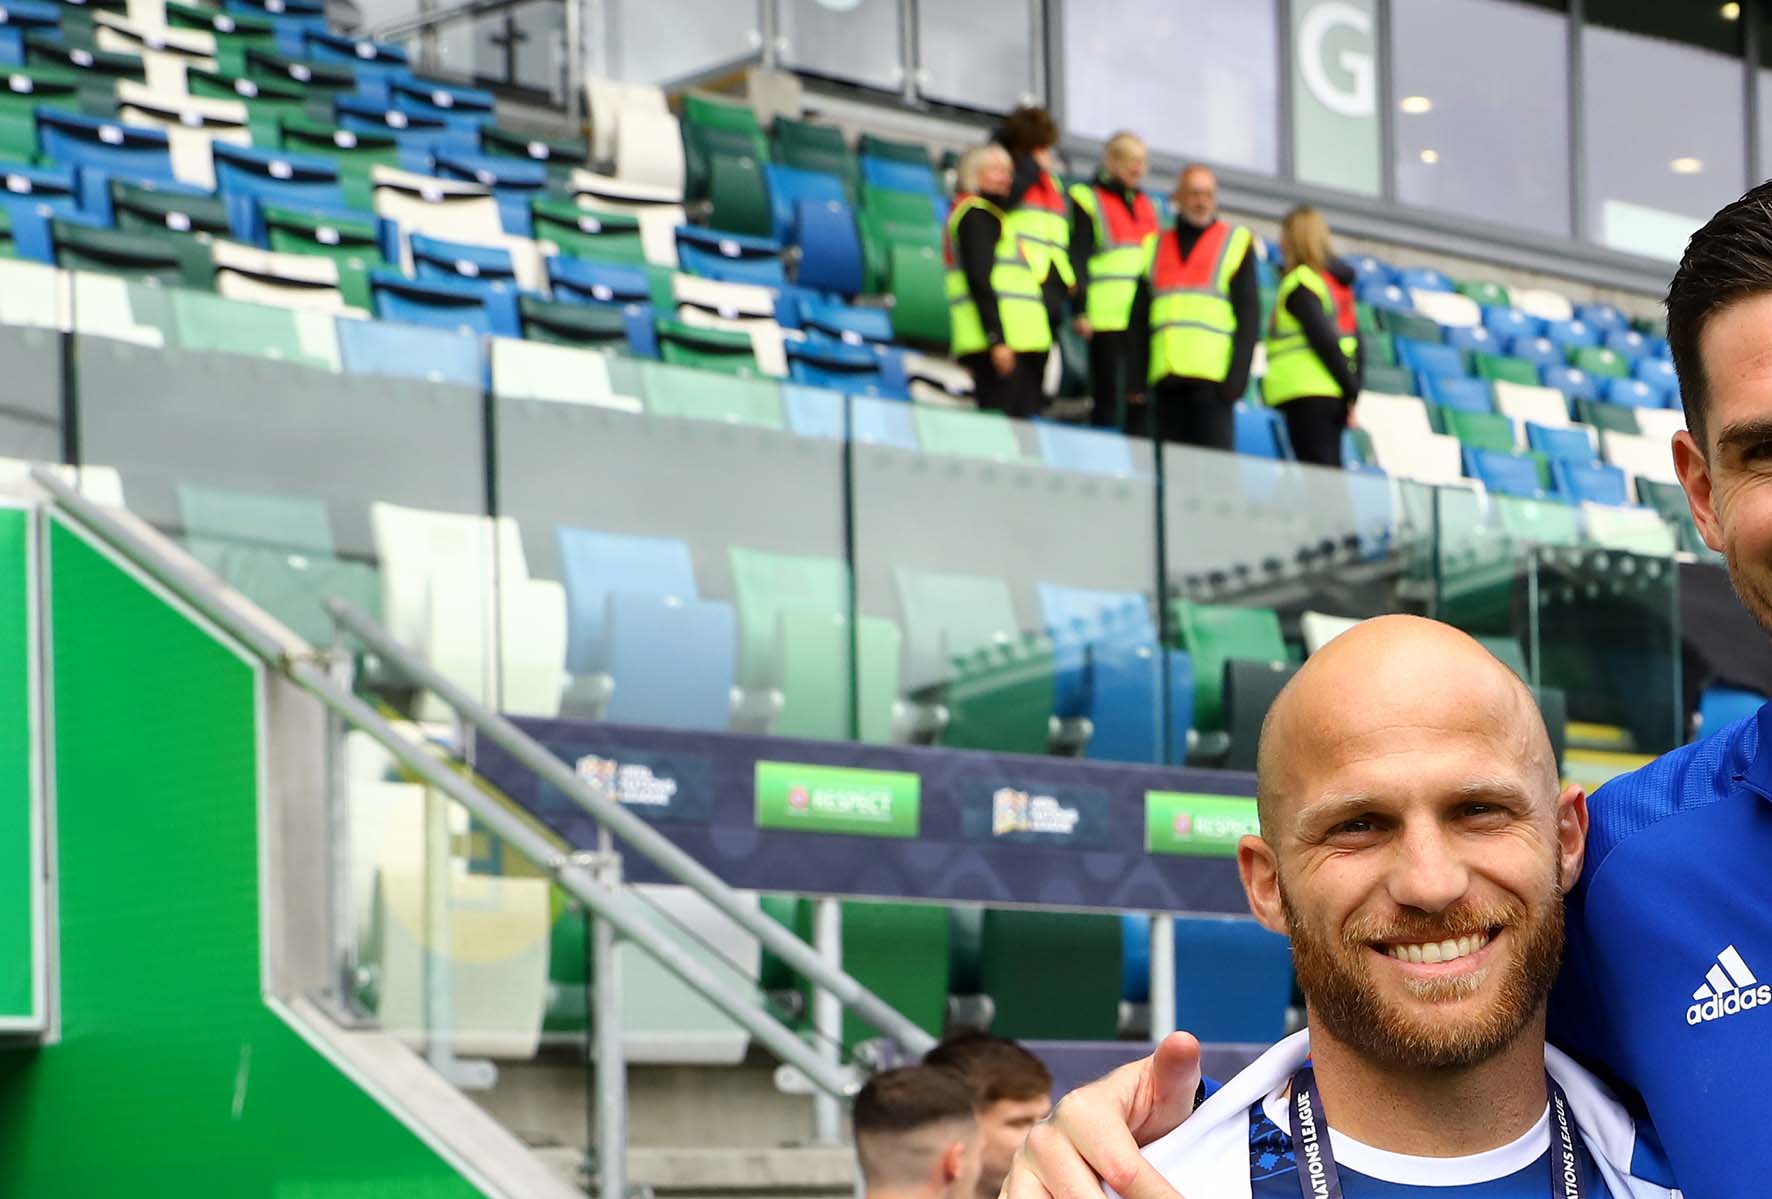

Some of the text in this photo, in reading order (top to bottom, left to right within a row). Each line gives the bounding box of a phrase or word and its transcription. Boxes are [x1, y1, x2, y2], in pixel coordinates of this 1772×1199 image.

[1299, 1, 1374, 118] G
[1686, 984, 1772, 1026] adidas
[1297, 1091, 1318, 1143] LEAGUE
[1555, 1095, 1574, 1151] LEAGUE
